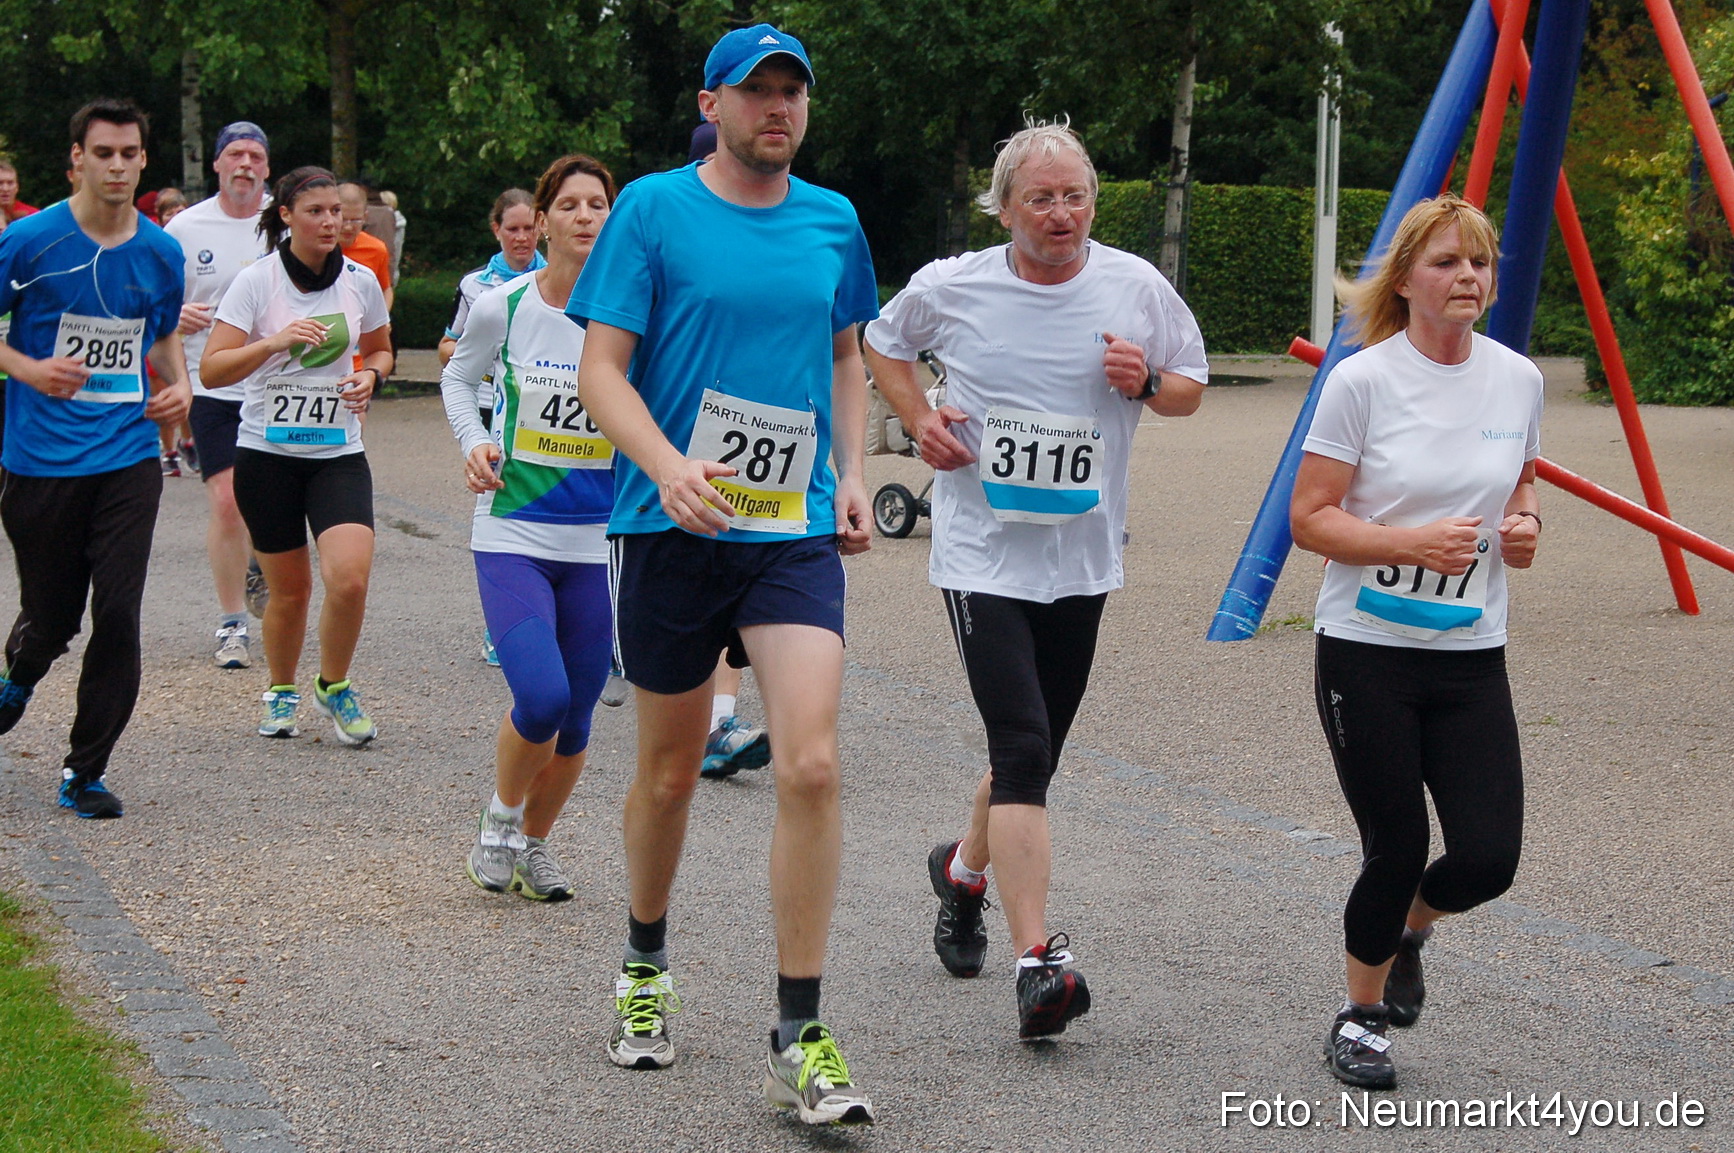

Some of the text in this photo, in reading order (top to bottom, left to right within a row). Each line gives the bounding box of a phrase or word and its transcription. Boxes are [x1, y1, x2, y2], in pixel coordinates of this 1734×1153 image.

[61, 321, 93, 333] PARTL
[66, 336, 133, 369] 2895
[266, 383, 334, 393] PARTL Neumarkt
[525, 375, 561, 388] PARTL
[273, 395, 339, 424] 2747
[702, 401, 809, 437] PARTL Neumarkt
[287, 431, 325, 442] Kerstin
[987, 417, 1088, 439] PARTL Neumarkt
[1481, 429, 1524, 440] Marianne
[538, 437, 595, 456] Manuela
[717, 430, 798, 484] 281
[991, 436, 1093, 484] 3116
